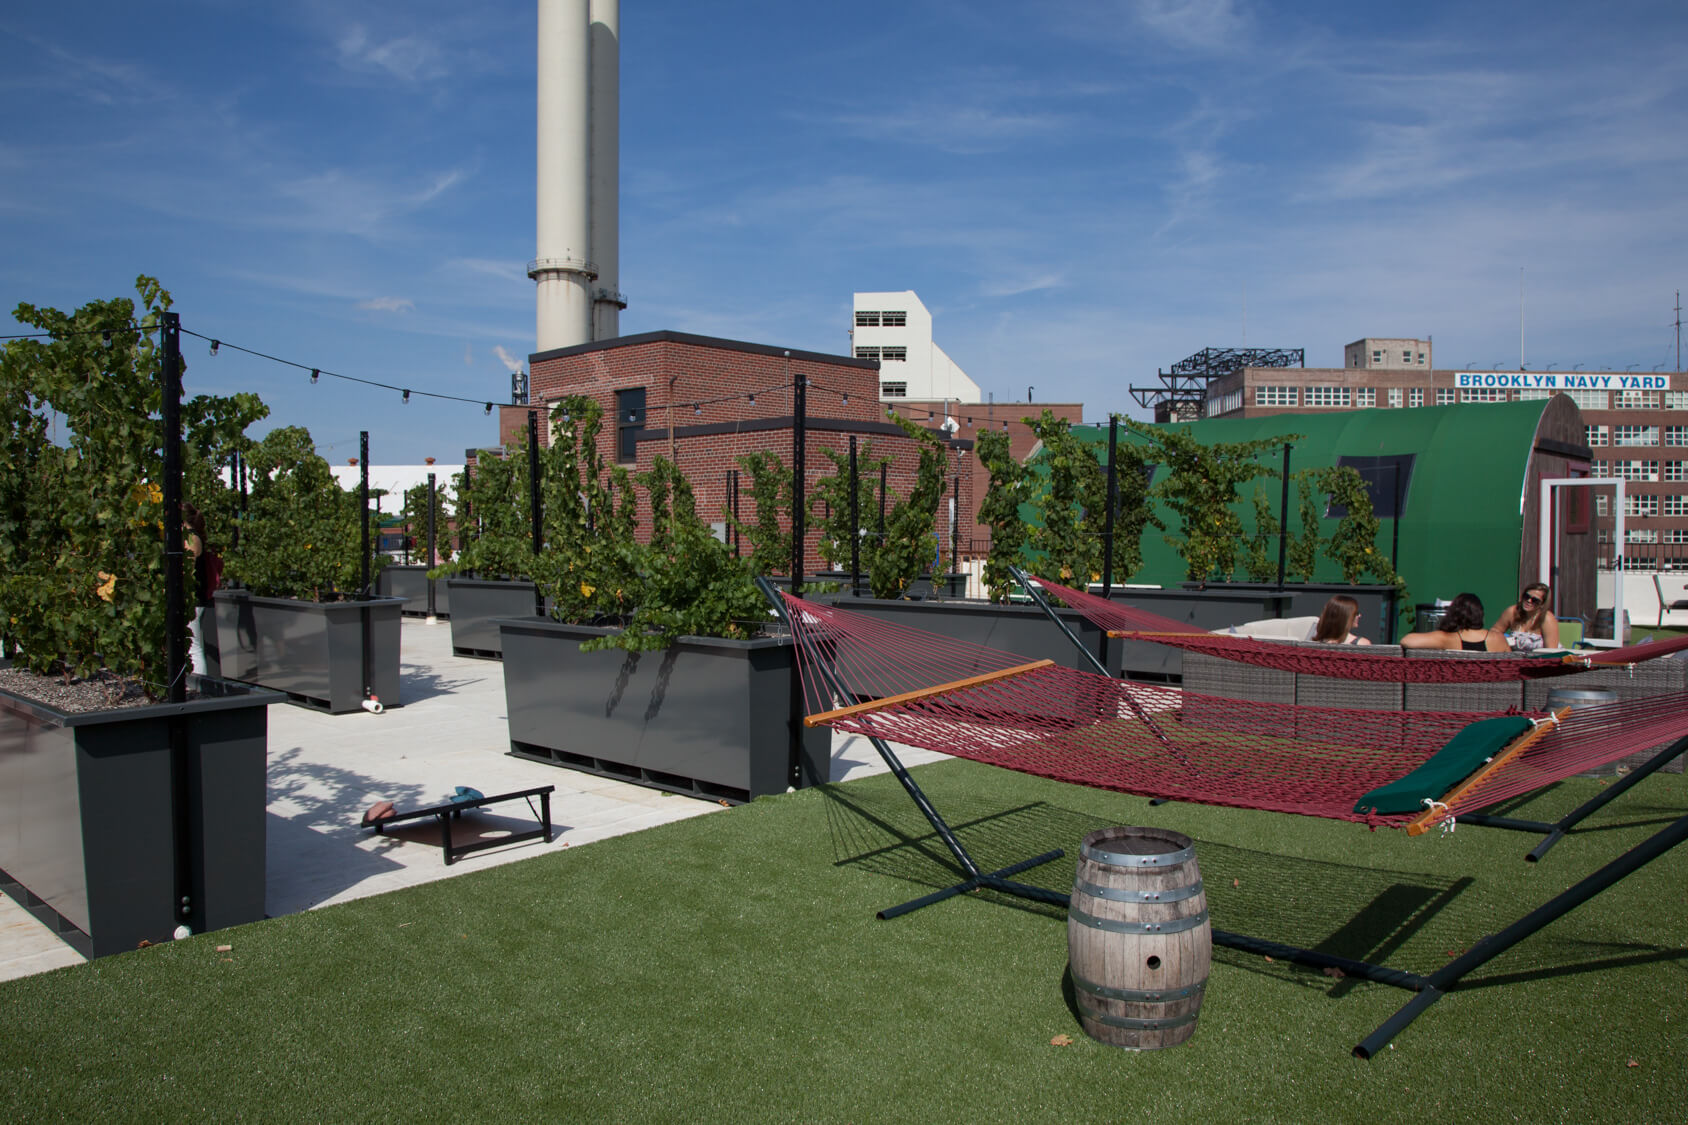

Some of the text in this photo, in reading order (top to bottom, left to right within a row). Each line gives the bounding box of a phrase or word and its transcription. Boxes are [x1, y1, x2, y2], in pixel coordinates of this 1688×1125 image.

[1459, 375, 1666, 388] BROOKLYN NAVY YARD
